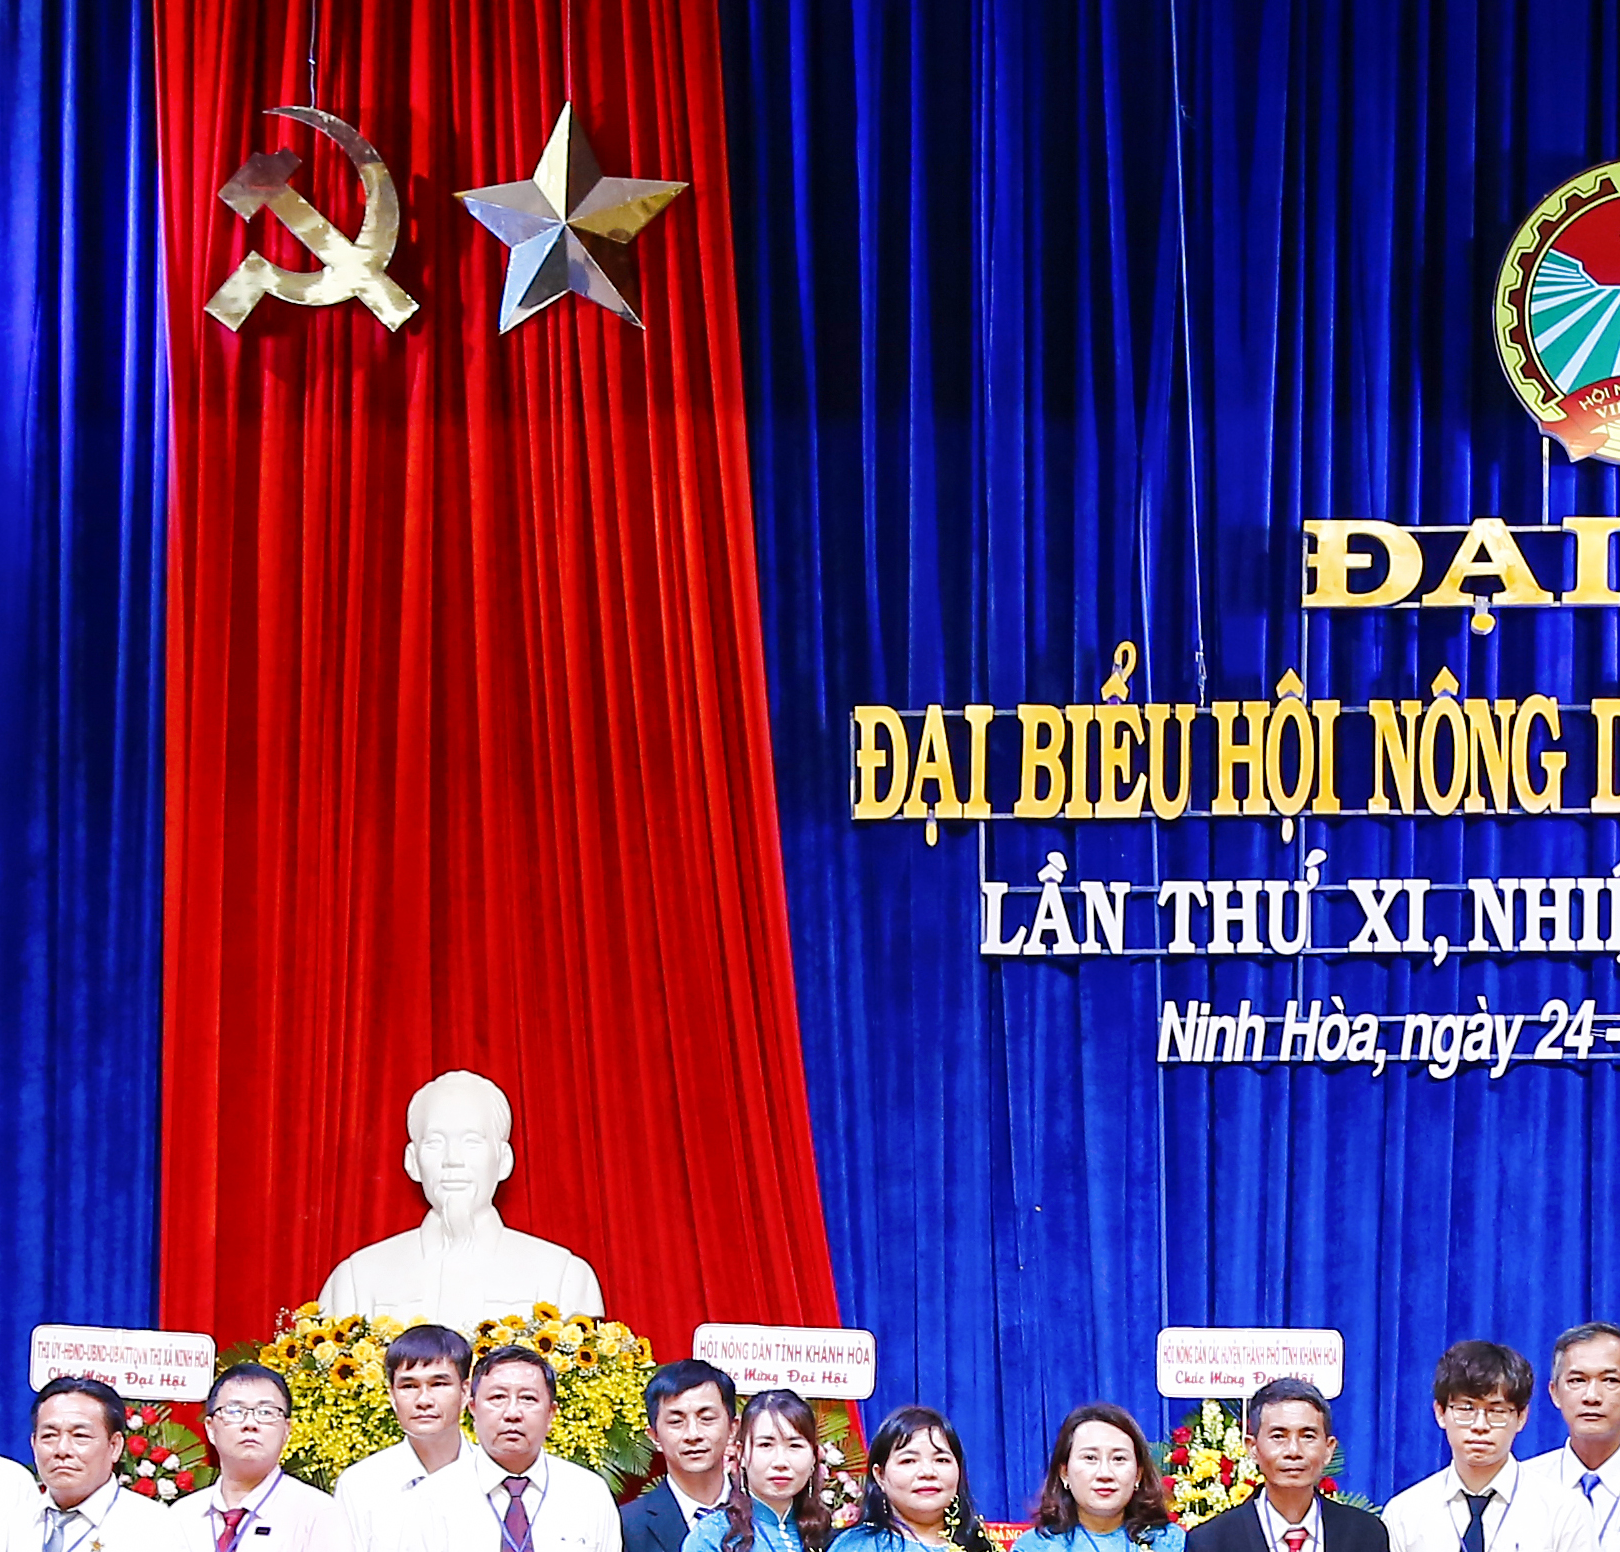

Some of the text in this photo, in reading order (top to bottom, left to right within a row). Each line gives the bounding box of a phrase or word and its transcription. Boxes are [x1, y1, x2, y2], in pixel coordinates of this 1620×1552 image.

[1578, 388, 1611, 412] HỘI
[854, 704, 993, 846] ĐẠI
[1013, 641, 1196, 820] BIỂU
[1211, 667, 1341, 843] HỘI
[1368, 666, 1567, 816] NÔNG
[980, 851, 1127, 955] LẦN
[1158, 849, 1328, 956] THỨ
[1348, 879, 1449, 967] XI,
[1156, 999, 1266, 1063] Ninh
[1279, 996, 1387, 1077] Hòa,
[1399, 996, 1525, 1079] ngày
[175, 1349, 193, 1367] NINH
[721, 1335, 749, 1360] NÔNG
[752, 1336, 772, 1362] DÂN
[805, 1339, 844, 1364] KHÁNH
[848, 1340, 871, 1365] HÒA
[124, 1372, 155, 1388] Đại
[160, 1373, 187, 1390] Hội
[787, 1370, 817, 1386] Đại
[821, 1371, 849, 1387] Hội
